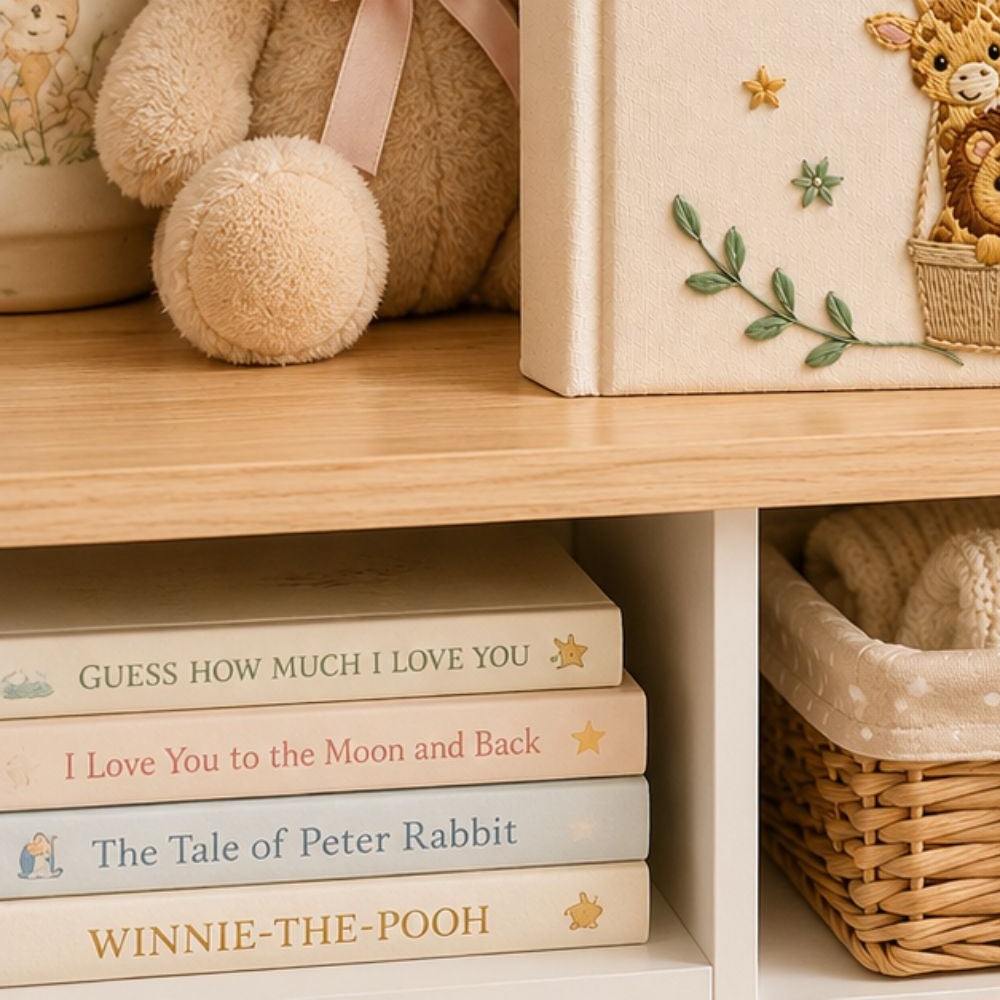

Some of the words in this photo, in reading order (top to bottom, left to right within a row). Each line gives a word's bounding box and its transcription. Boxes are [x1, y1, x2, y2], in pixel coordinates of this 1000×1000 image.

[79, 662, 177, 689] GUESS
[190, 658, 262, 683] HOW
[272, 653, 360, 680] MUCH
[373, 652, 381, 674] I
[392, 647, 463, 673] LOVE
[472, 645, 530, 669] YOU
[66, 753, 75, 780] I
[87, 752, 155, 779] Love
[165, 747, 219, 774] You
[230, 747, 259, 770] to
[270, 741, 314, 768] the
[325, 738, 404, 765] Moon
[415, 731, 464, 760] and
[475, 727, 540, 757] Back
[92, 838, 157, 868] The
[168, 832, 239, 864] Tale
[252, 827, 288, 861] of
[300, 827, 390, 857] Peter
[403, 817, 517, 851] Rabbit
[88, 905, 490, 959] WINNIE-THE-POOH
